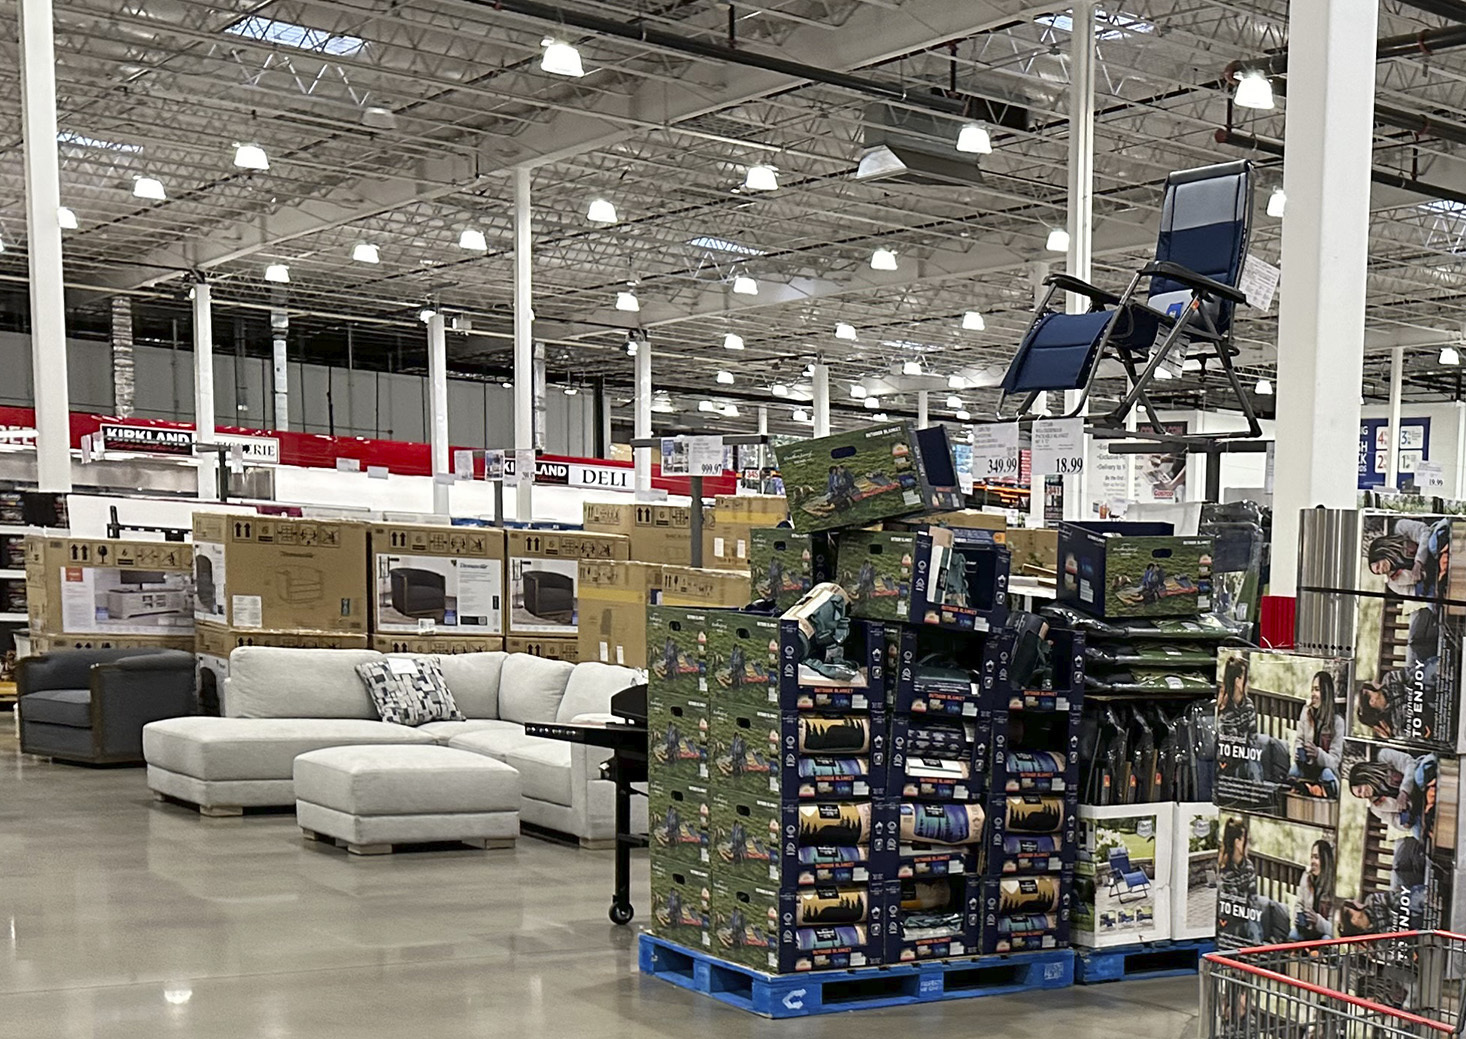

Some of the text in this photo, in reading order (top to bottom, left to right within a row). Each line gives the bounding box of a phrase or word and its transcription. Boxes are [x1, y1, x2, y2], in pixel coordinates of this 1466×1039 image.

[106, 427, 190, 446] KIRKLAND
[504, 459, 567, 478] KILAND
[988, 458, 1018, 474] 349.99
[1056, 458, 1083, 473] 18.99
[582, 470, 627, 487] DELI
[1412, 660, 1425, 738] TO ENJOY
[1218, 743, 1262, 761] TO ENJOY
[1220, 900, 1262, 922] TO ENJOY
